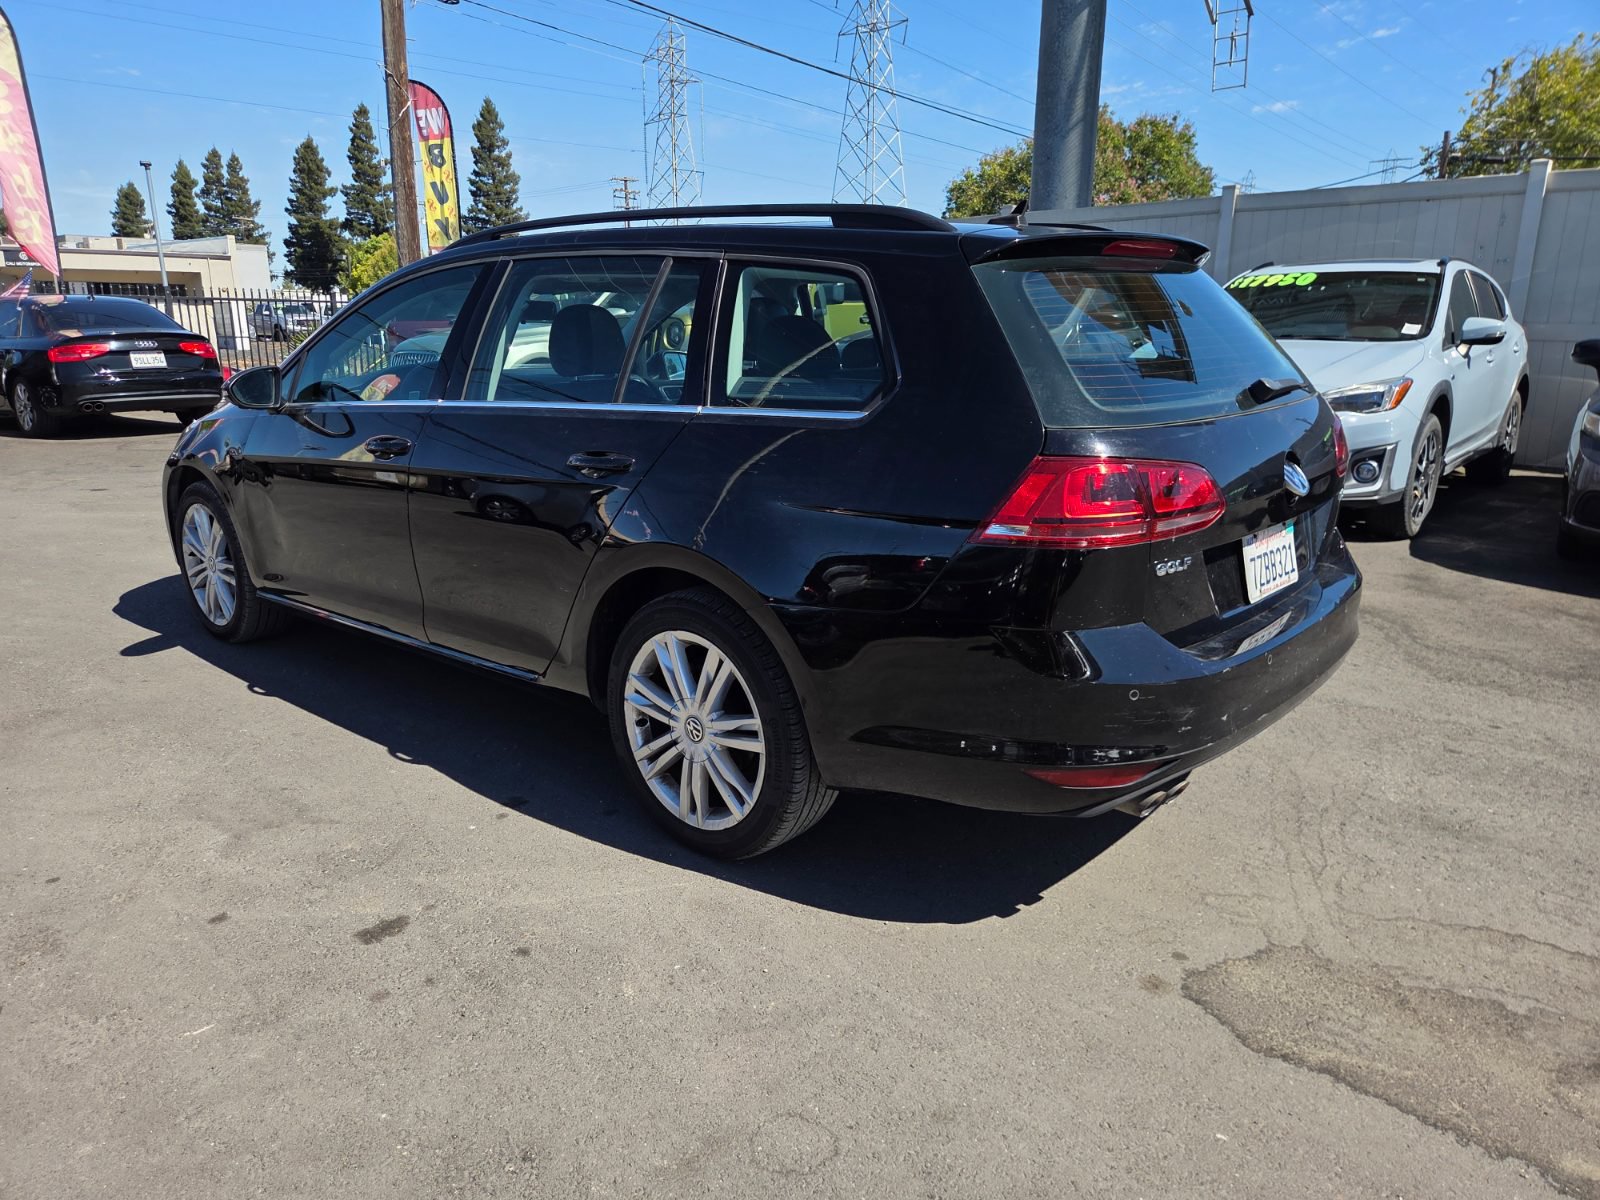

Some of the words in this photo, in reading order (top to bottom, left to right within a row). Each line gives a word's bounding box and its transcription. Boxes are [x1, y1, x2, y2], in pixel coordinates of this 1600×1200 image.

[1229, 272, 1317, 287] $17950
[1156, 556, 1192, 577] GOLF
[1249, 542, 1296, 591] 7ZBB321
